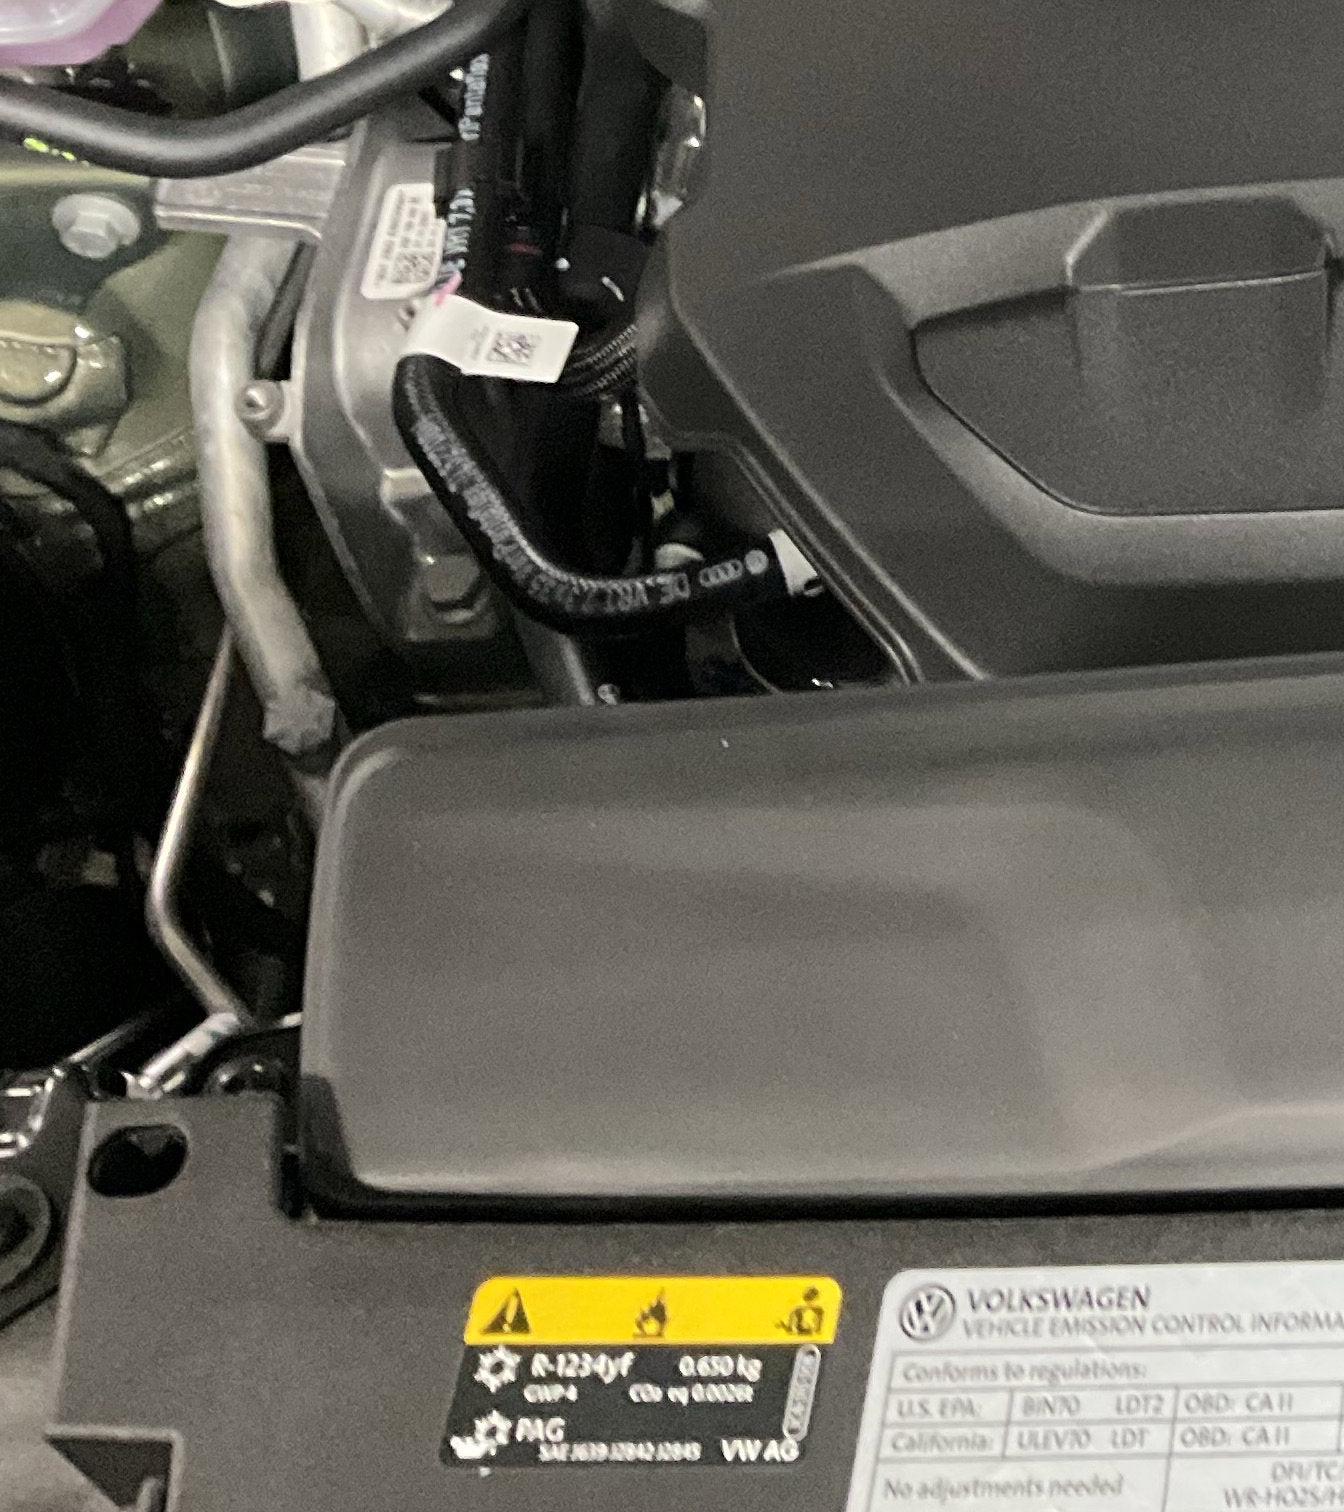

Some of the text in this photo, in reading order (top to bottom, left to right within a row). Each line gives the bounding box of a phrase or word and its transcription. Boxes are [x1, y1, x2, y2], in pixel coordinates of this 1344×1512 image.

[965, 1285, 1151, 1313] VOLKSWAGEN
[961, 1316, 1044, 1338] VEHICLE
[1048, 1314, 1146, 1337] EMISSION
[1149, 1312, 1246, 1335] CONTROL
[737, 1354, 763, 1382] kg
[901, 1361, 999, 1382] Conforms
[1002, 1361, 1025, 1381] to
[1021, 1394, 1165, 1415] BIN70 LDT2
[1244, 1392, 1275, 1412] CA
[1015, 1428, 1149, 1449] ULEV70 LDT
[1240, 1426, 1270, 1447] CA
[720, 1437, 800, 1463] VW AG
[883, 1472, 1125, 1504] No adjustments needed
